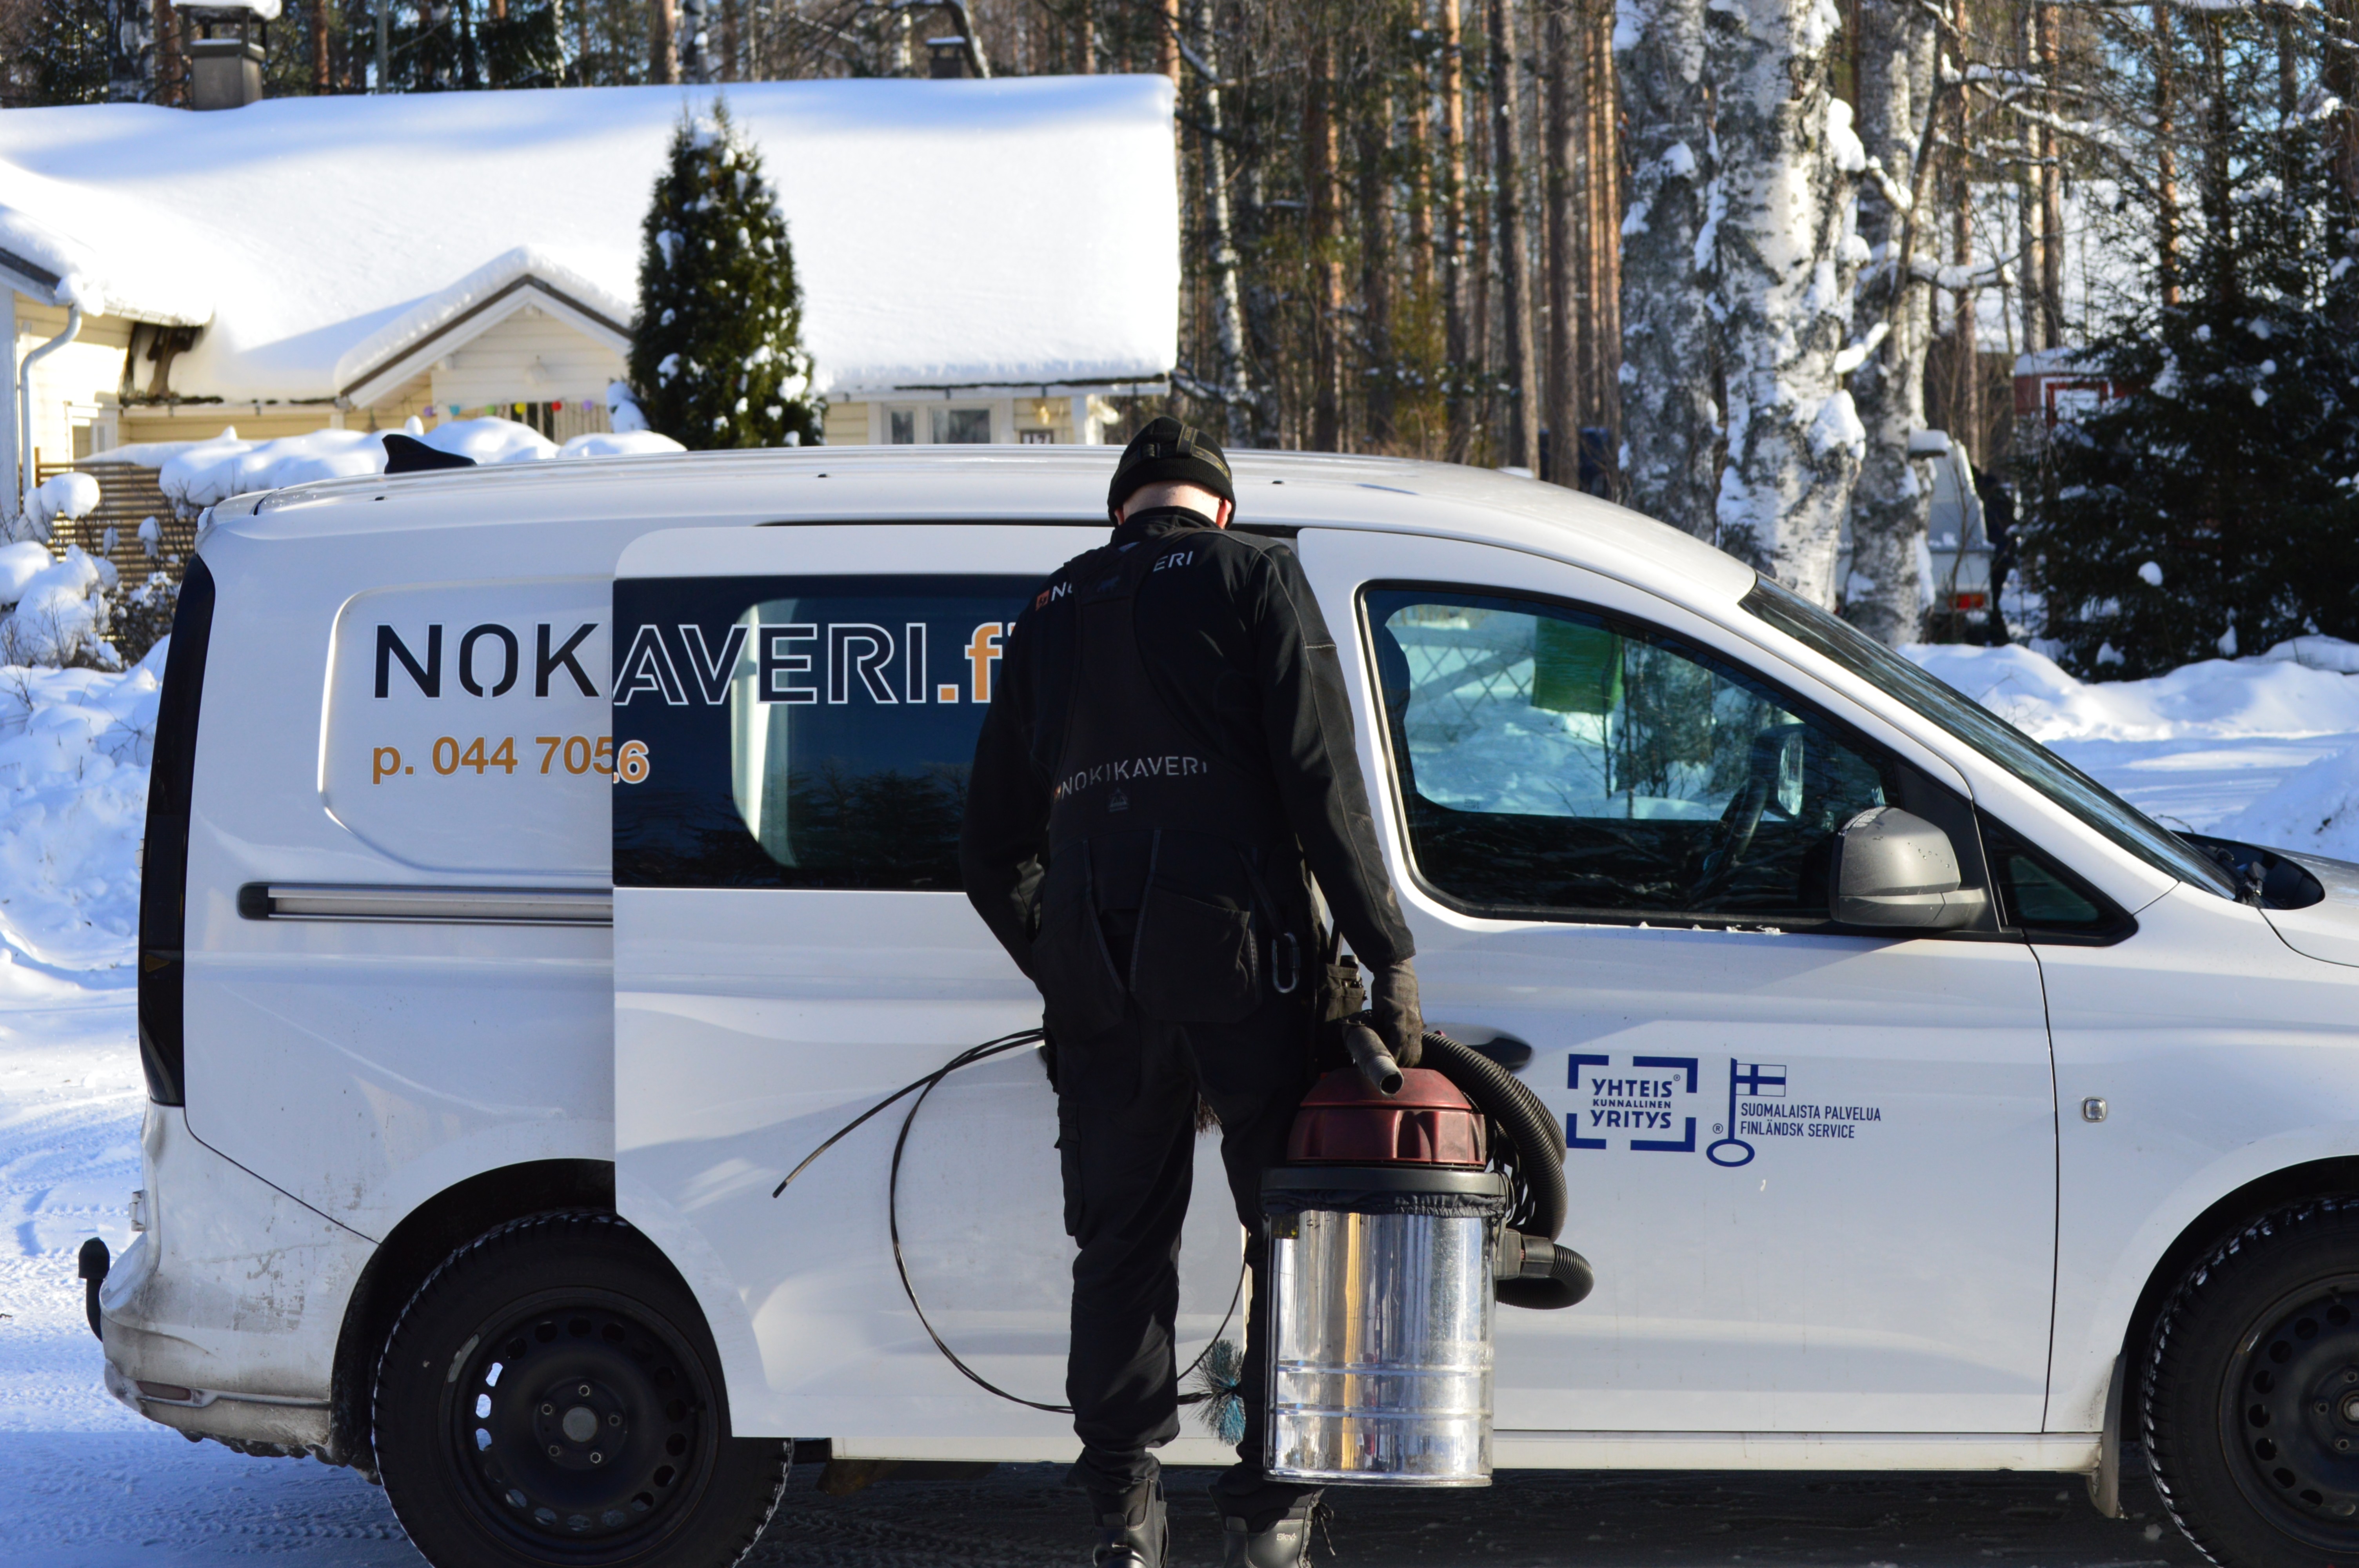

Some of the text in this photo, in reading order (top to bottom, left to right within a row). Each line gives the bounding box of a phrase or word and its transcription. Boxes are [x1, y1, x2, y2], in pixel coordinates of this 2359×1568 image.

[372, 746, 414, 784] p.
[432, 736, 518, 775] 044
[1591, 1078, 1672, 1098] YHTEIS
[1593, 1099, 1671, 1109] KUNNALLINEN
[1741, 1103, 1881, 1122] SUOMALAISTA PALVELUA
[1590, 1110, 1672, 1129] YRITYS
[1740, 1119, 1855, 1139] FINLÄNDSK SERVICE
